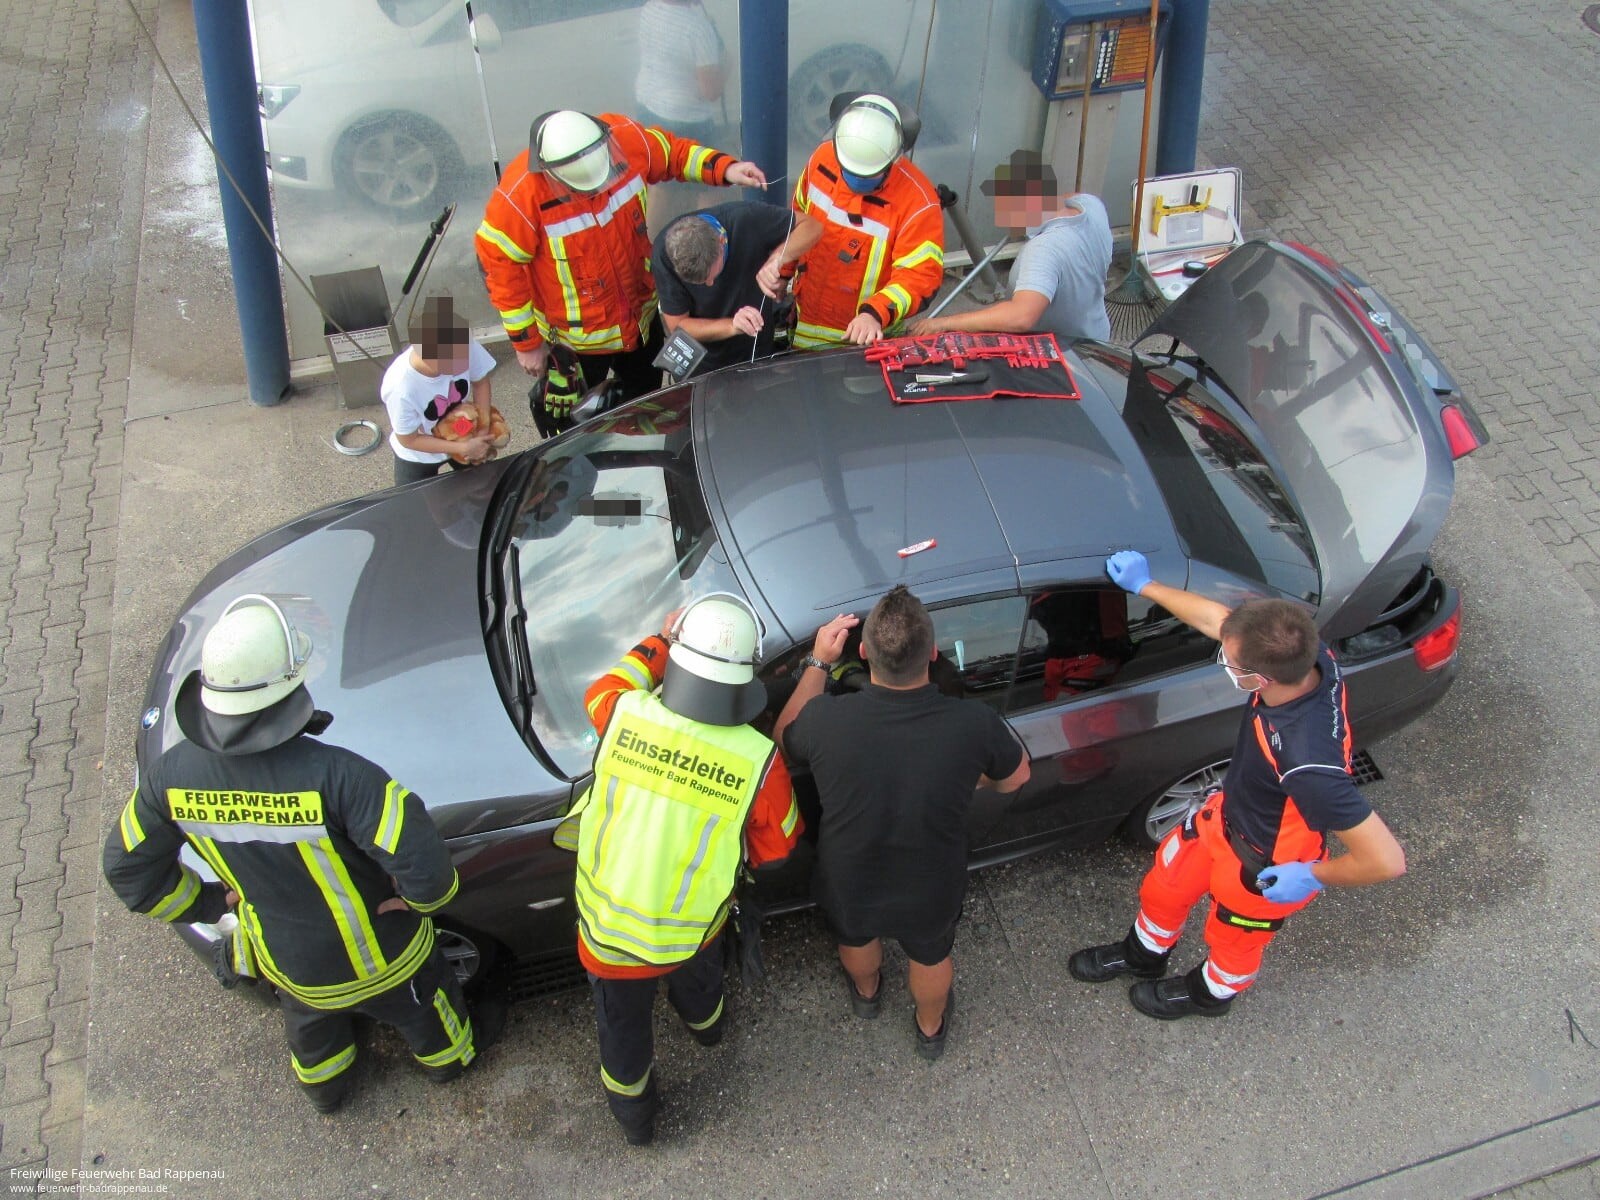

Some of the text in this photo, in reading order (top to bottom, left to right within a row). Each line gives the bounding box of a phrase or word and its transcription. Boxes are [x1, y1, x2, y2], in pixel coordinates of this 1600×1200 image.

[611, 750, 740, 806] Feuerwehr Bad Rappenau
[616, 728, 745, 791] Einsatzleiter
[174, 806, 318, 824] BAD RAPPENAU
[185, 791, 301, 808] FEUERWEHR
